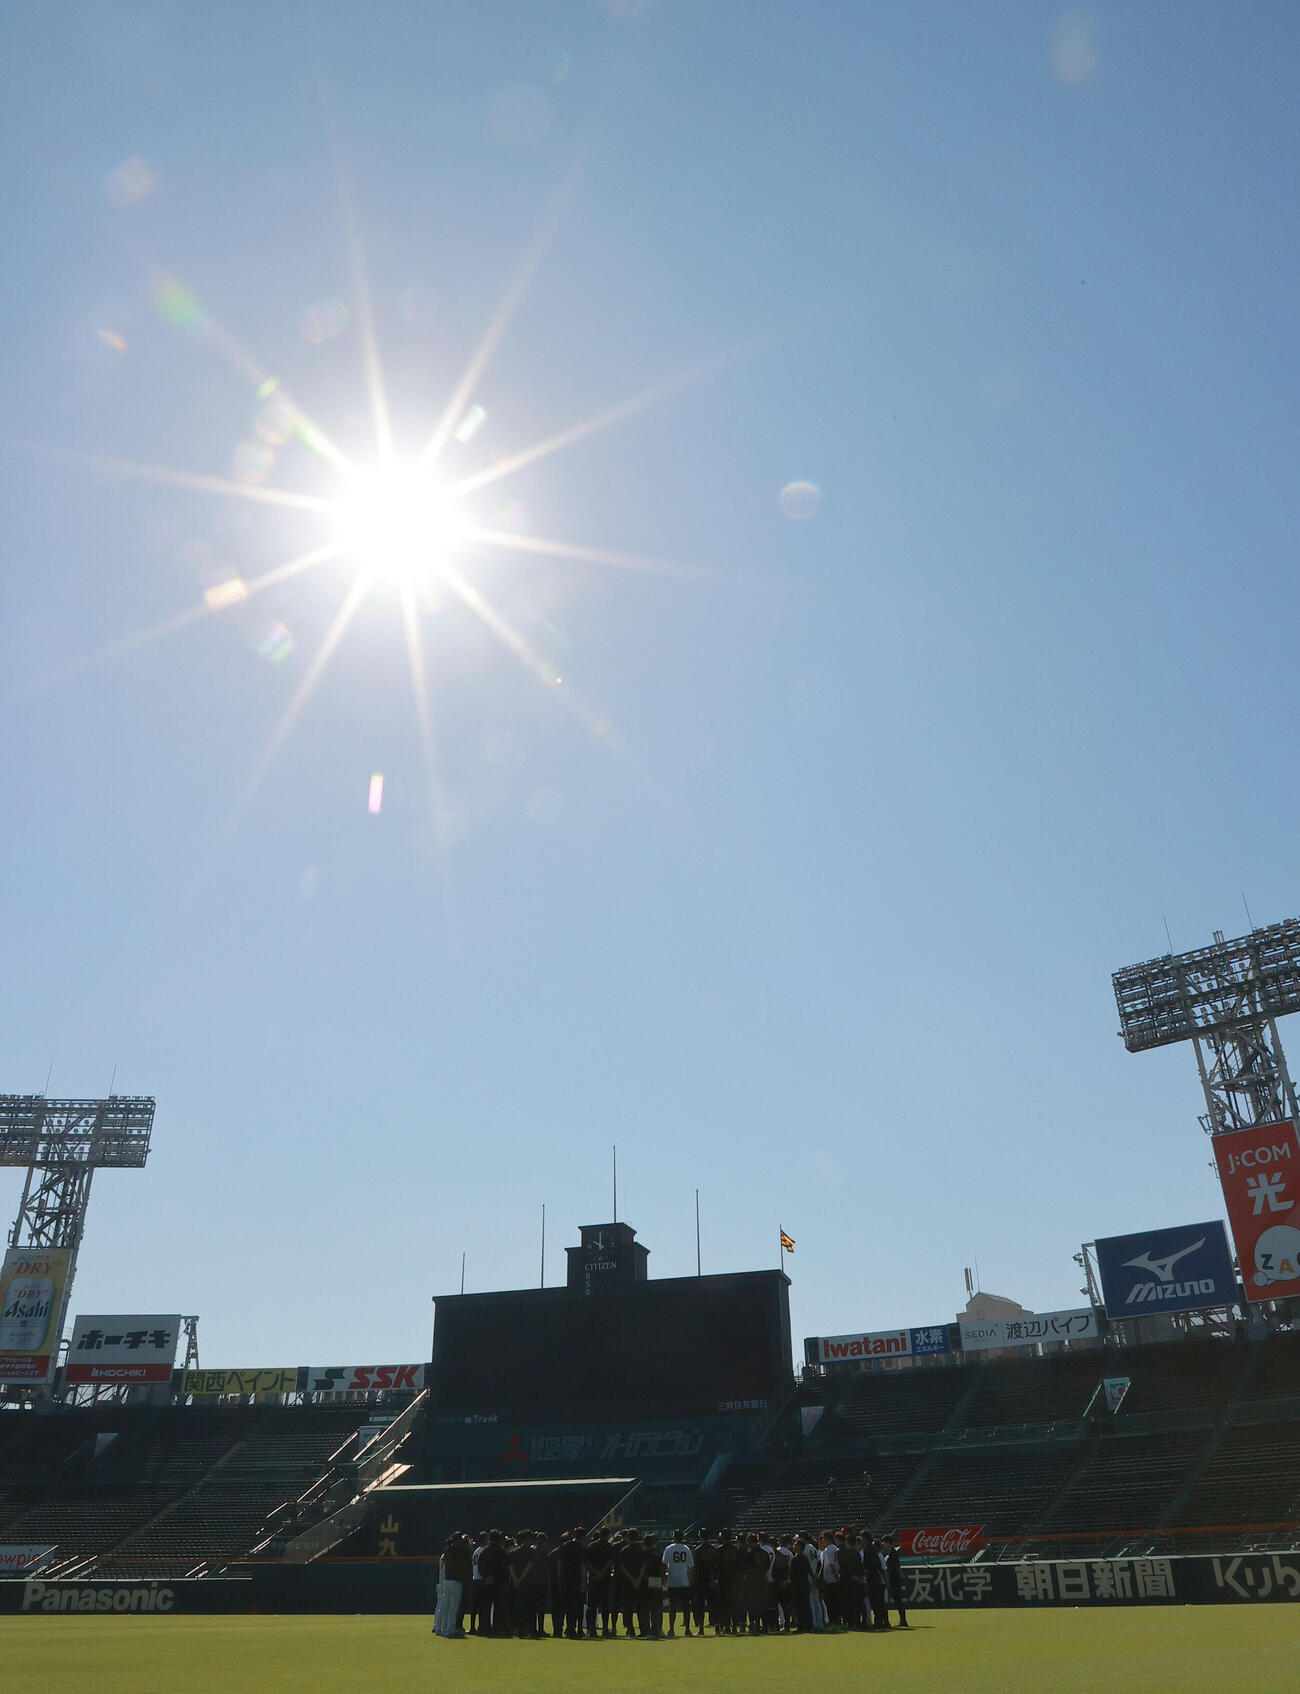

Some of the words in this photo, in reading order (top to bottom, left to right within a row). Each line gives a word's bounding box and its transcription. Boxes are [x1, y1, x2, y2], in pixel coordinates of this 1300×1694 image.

[1228, 1141, 1292, 1175] J:COM
[1246, 1171, 1295, 1216] 光
[584, 1261, 617, 1271] CITIZEN
[1261, 1252, 1300, 1275] ZA
[1125, 1278, 1216, 1304] MIZUNO
[5, 1299, 50, 1319] Asahi
[915, 1328, 944, 1346] 水素
[965, 1328, 997, 1339] SEDIA
[1005, 1312, 1093, 1340] 渡辺パイプ
[77, 1330, 171, 1350] ホーチキ
[823, 1332, 908, 1359] Iwatani
[100, 1367, 147, 1378] HOCHIKI
[184, 1370, 295, 1393] 関西ペイント
[348, 1366, 420, 1390] SSK
[912, 1528, 972, 1554] Coca-Cola
[672, 1551, 687, 1564] 60
[1014, 1558, 1176, 1601] 朝日新聞
[22, 1581, 174, 1611] Panasonic
